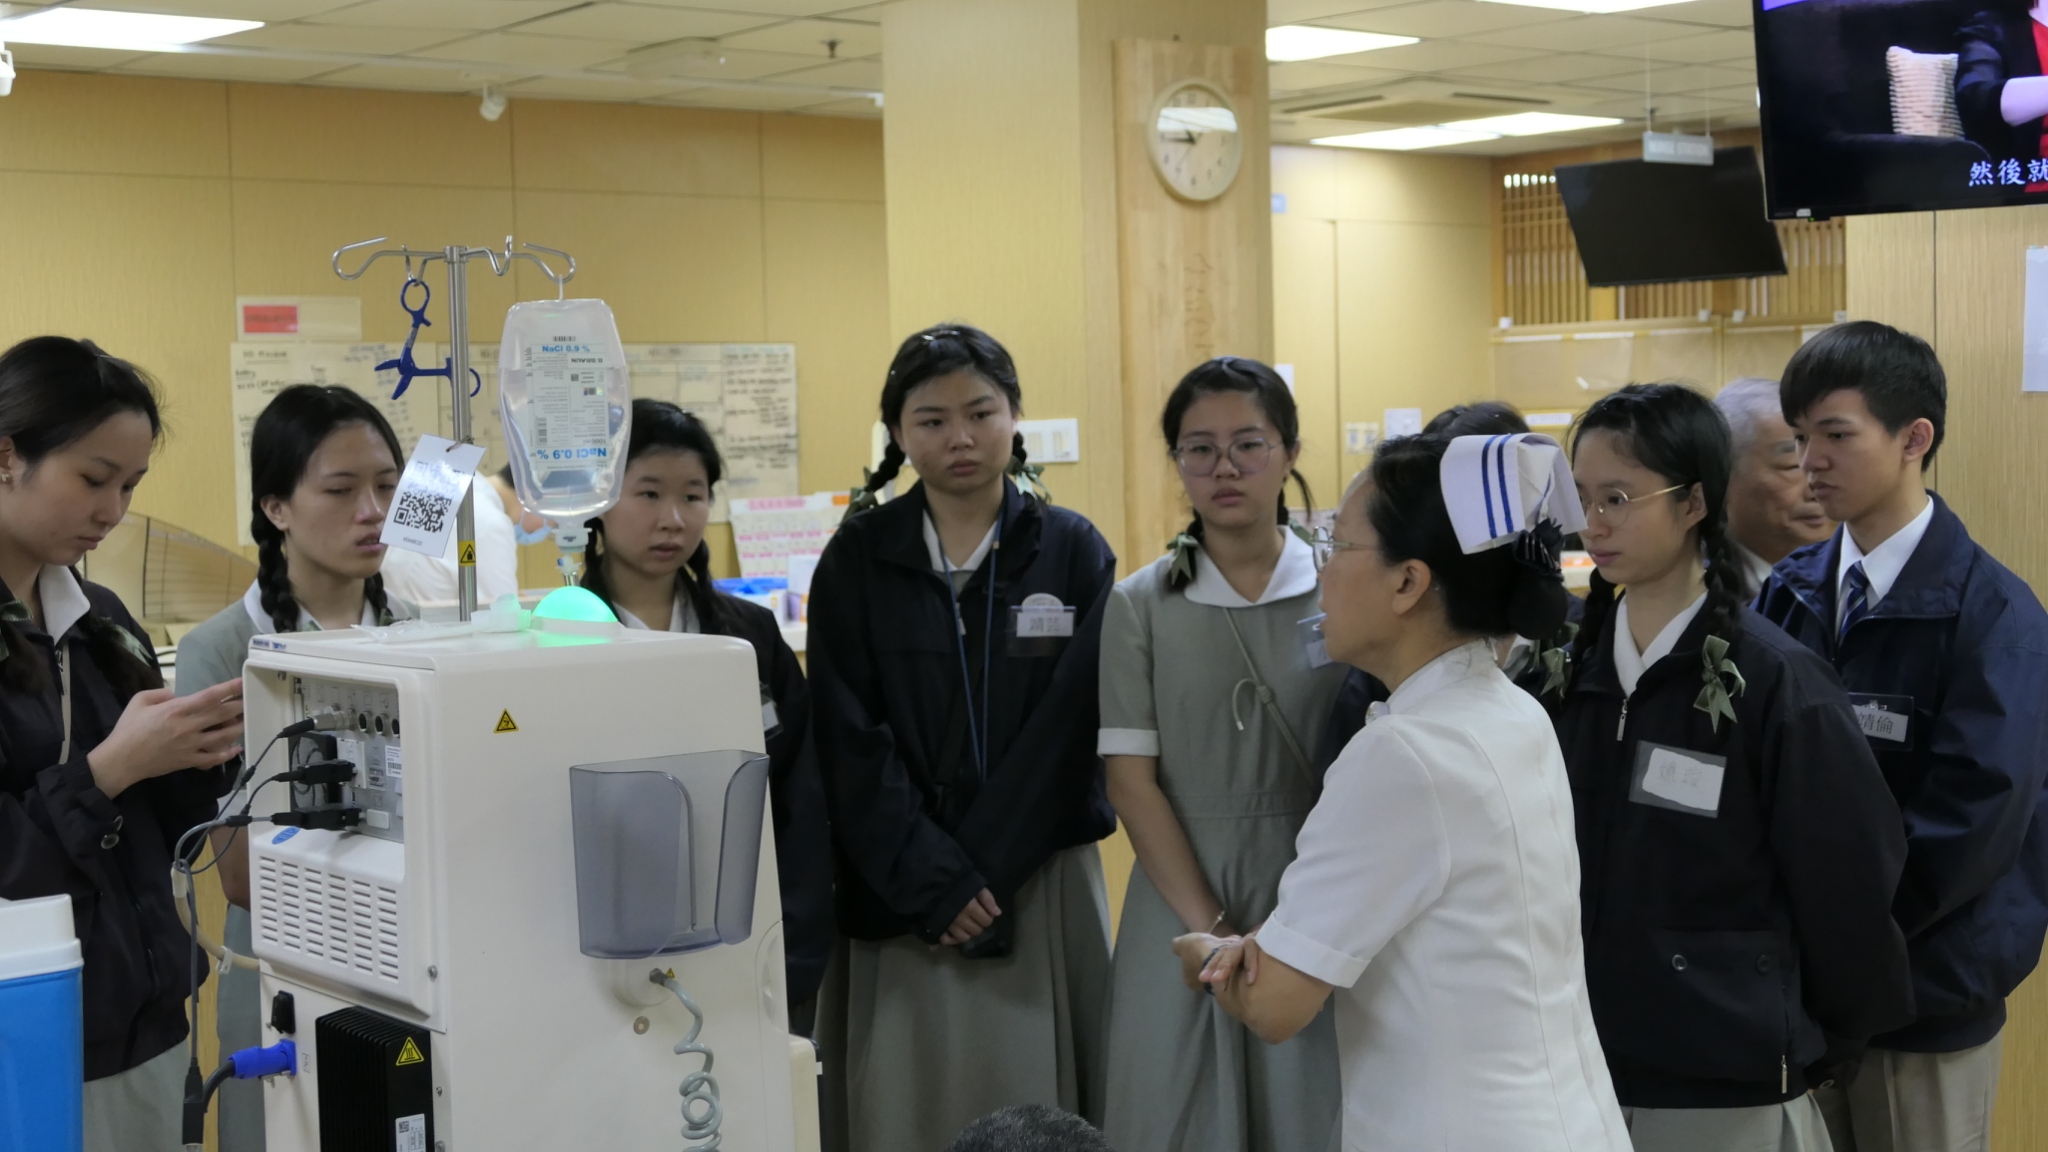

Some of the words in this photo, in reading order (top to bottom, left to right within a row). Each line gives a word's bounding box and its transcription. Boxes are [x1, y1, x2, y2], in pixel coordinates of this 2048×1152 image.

[1968, 158, 2048, 187] 然後就
[542, 345, 563, 353] NaCl
[566, 345, 580, 353] 0.9
[537, 450, 549, 459] %
[553, 449, 573, 459] 0.9
[577, 448, 607, 458] NaCl
